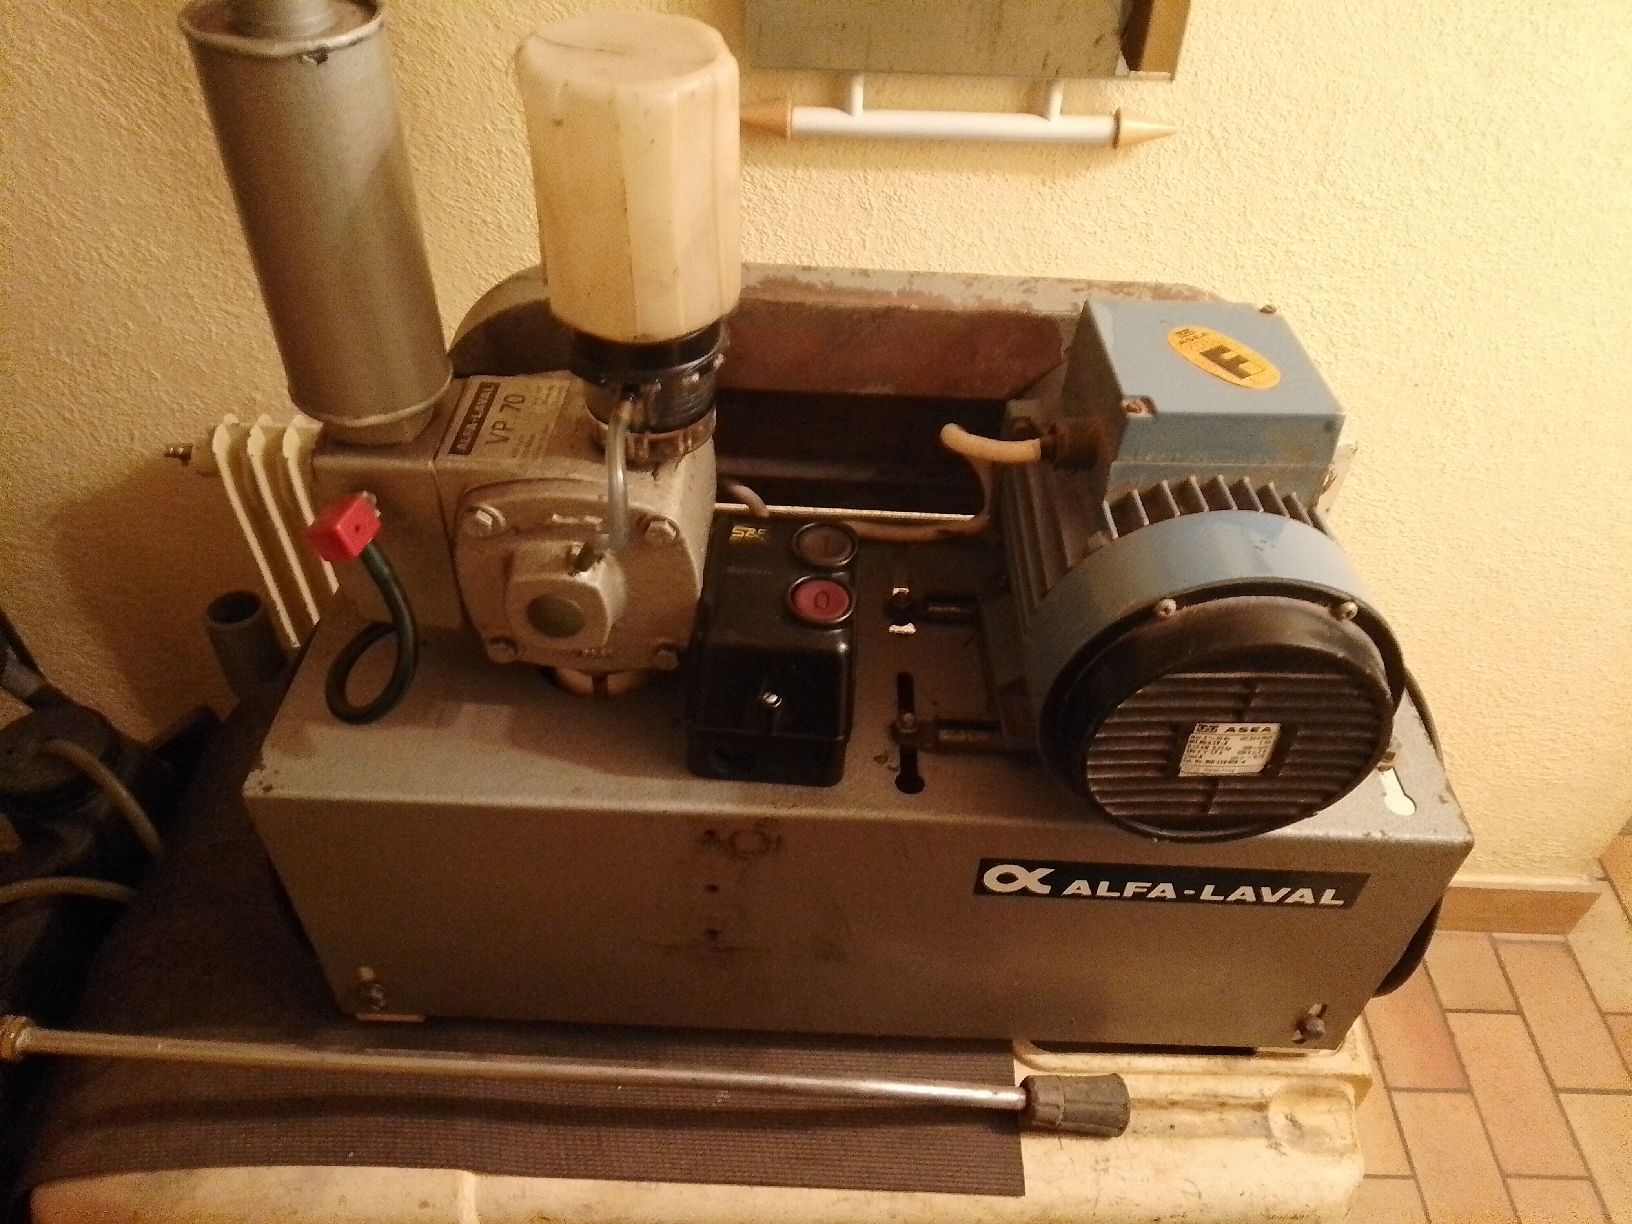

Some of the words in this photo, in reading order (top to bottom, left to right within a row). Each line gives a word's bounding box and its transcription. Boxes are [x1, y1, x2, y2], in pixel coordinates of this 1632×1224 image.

[499, 393, 527, 413] 70
[485, 420, 515, 445] VP
[1061, 879, 1344, 905] ALFA-LAVAL
